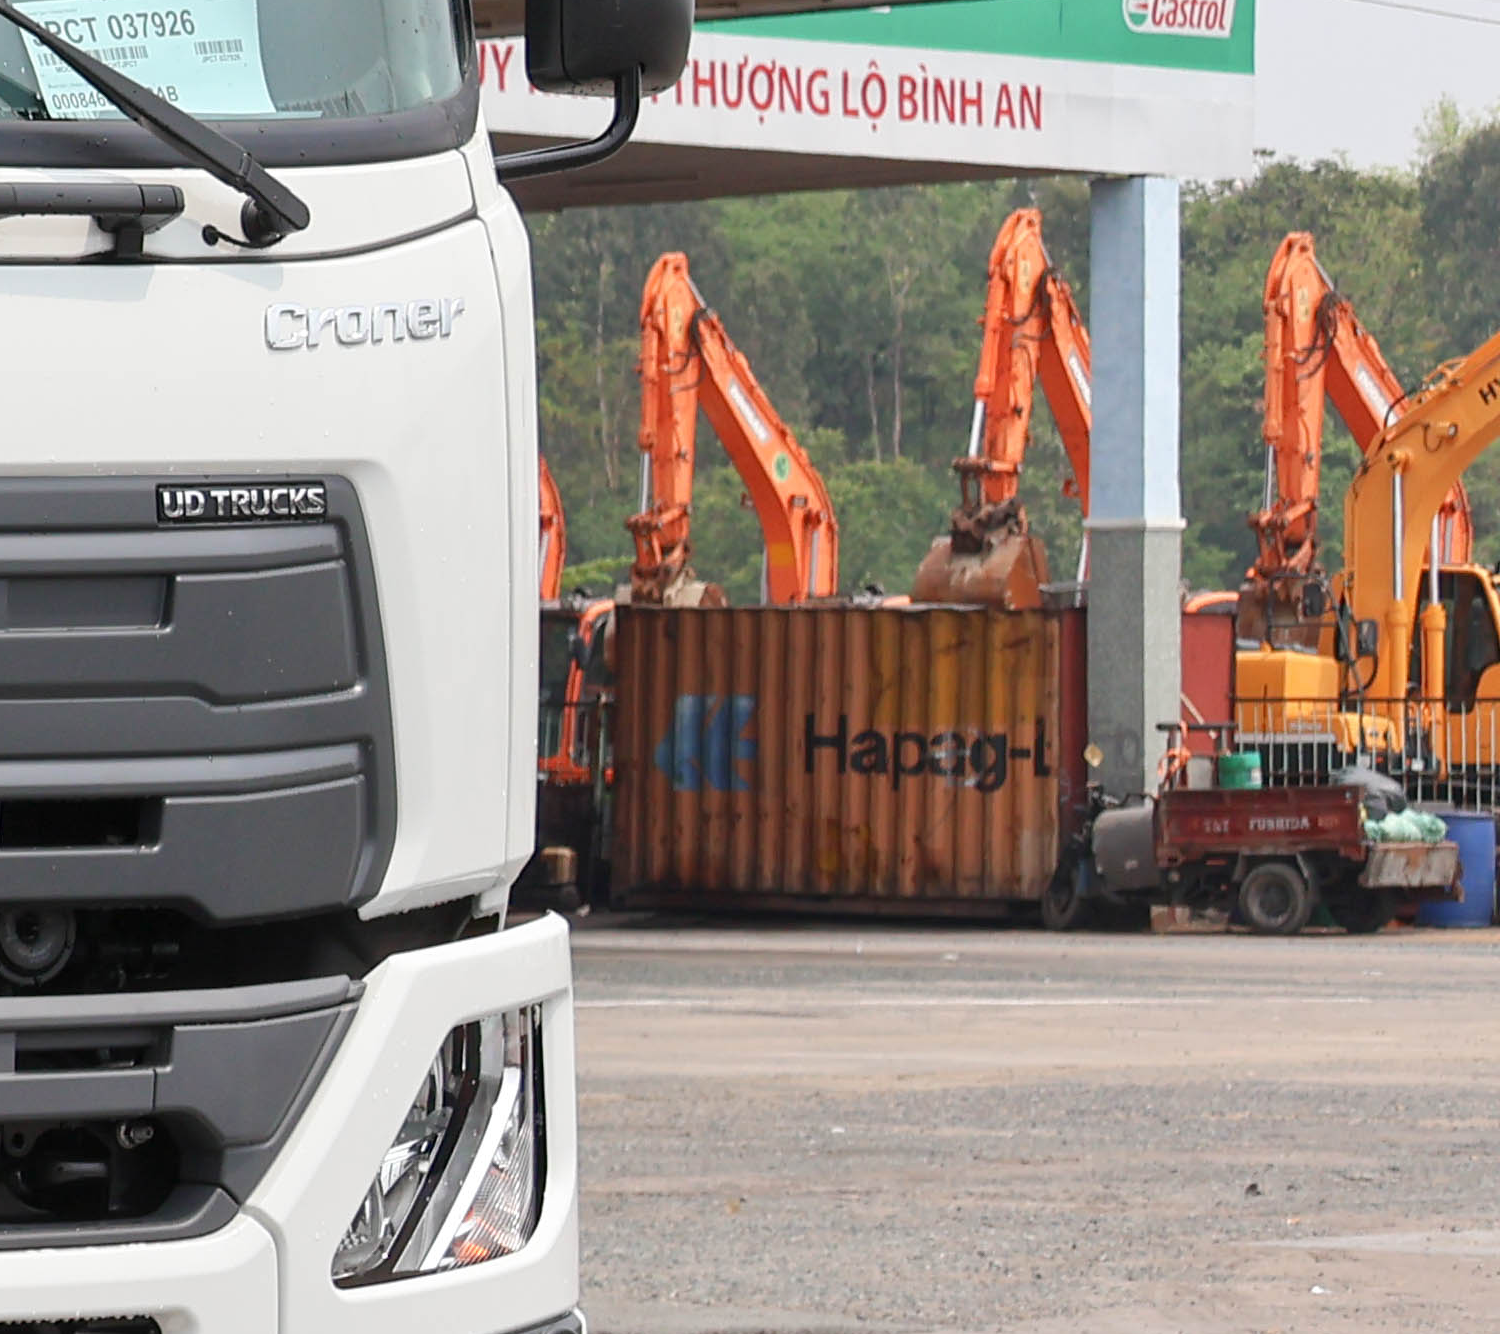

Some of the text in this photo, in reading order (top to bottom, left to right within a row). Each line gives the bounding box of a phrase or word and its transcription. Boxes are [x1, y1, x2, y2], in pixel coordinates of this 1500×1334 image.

[107, 9, 195, 41] 037926
[840, 59, 888, 132] LỘ
[900, 64, 983, 127] BÌNH
[993, 82, 1043, 131] AN
[264, 295, 465, 351] Croner
[162, 486, 326, 519] UD TRUCKS
